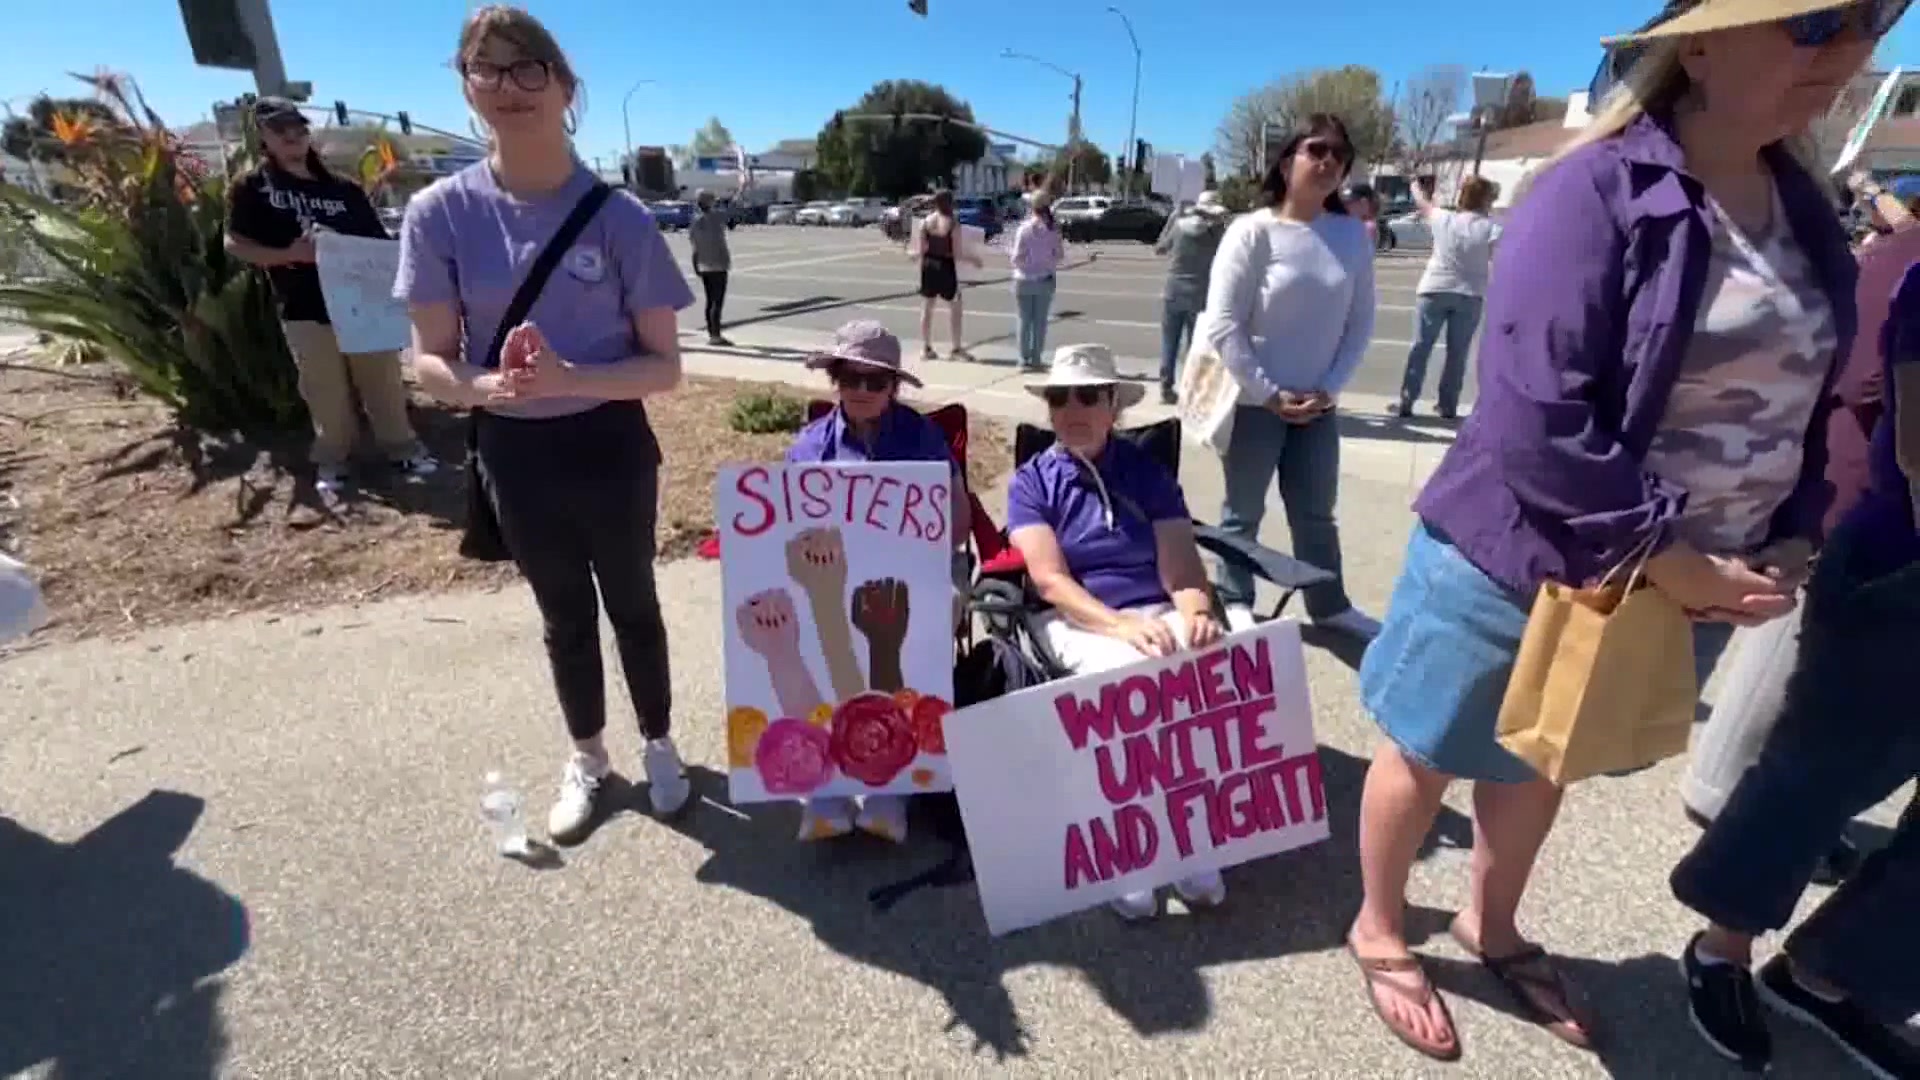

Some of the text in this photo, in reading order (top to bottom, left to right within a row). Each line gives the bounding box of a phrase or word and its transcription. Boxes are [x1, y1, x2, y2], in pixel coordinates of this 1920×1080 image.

[732, 467, 948, 541] SISTERS
[1055, 637, 1274, 749] WOMEN
[1095, 696, 1283, 804] UNITE
[1065, 752, 1324, 890] AND FIGHT!
